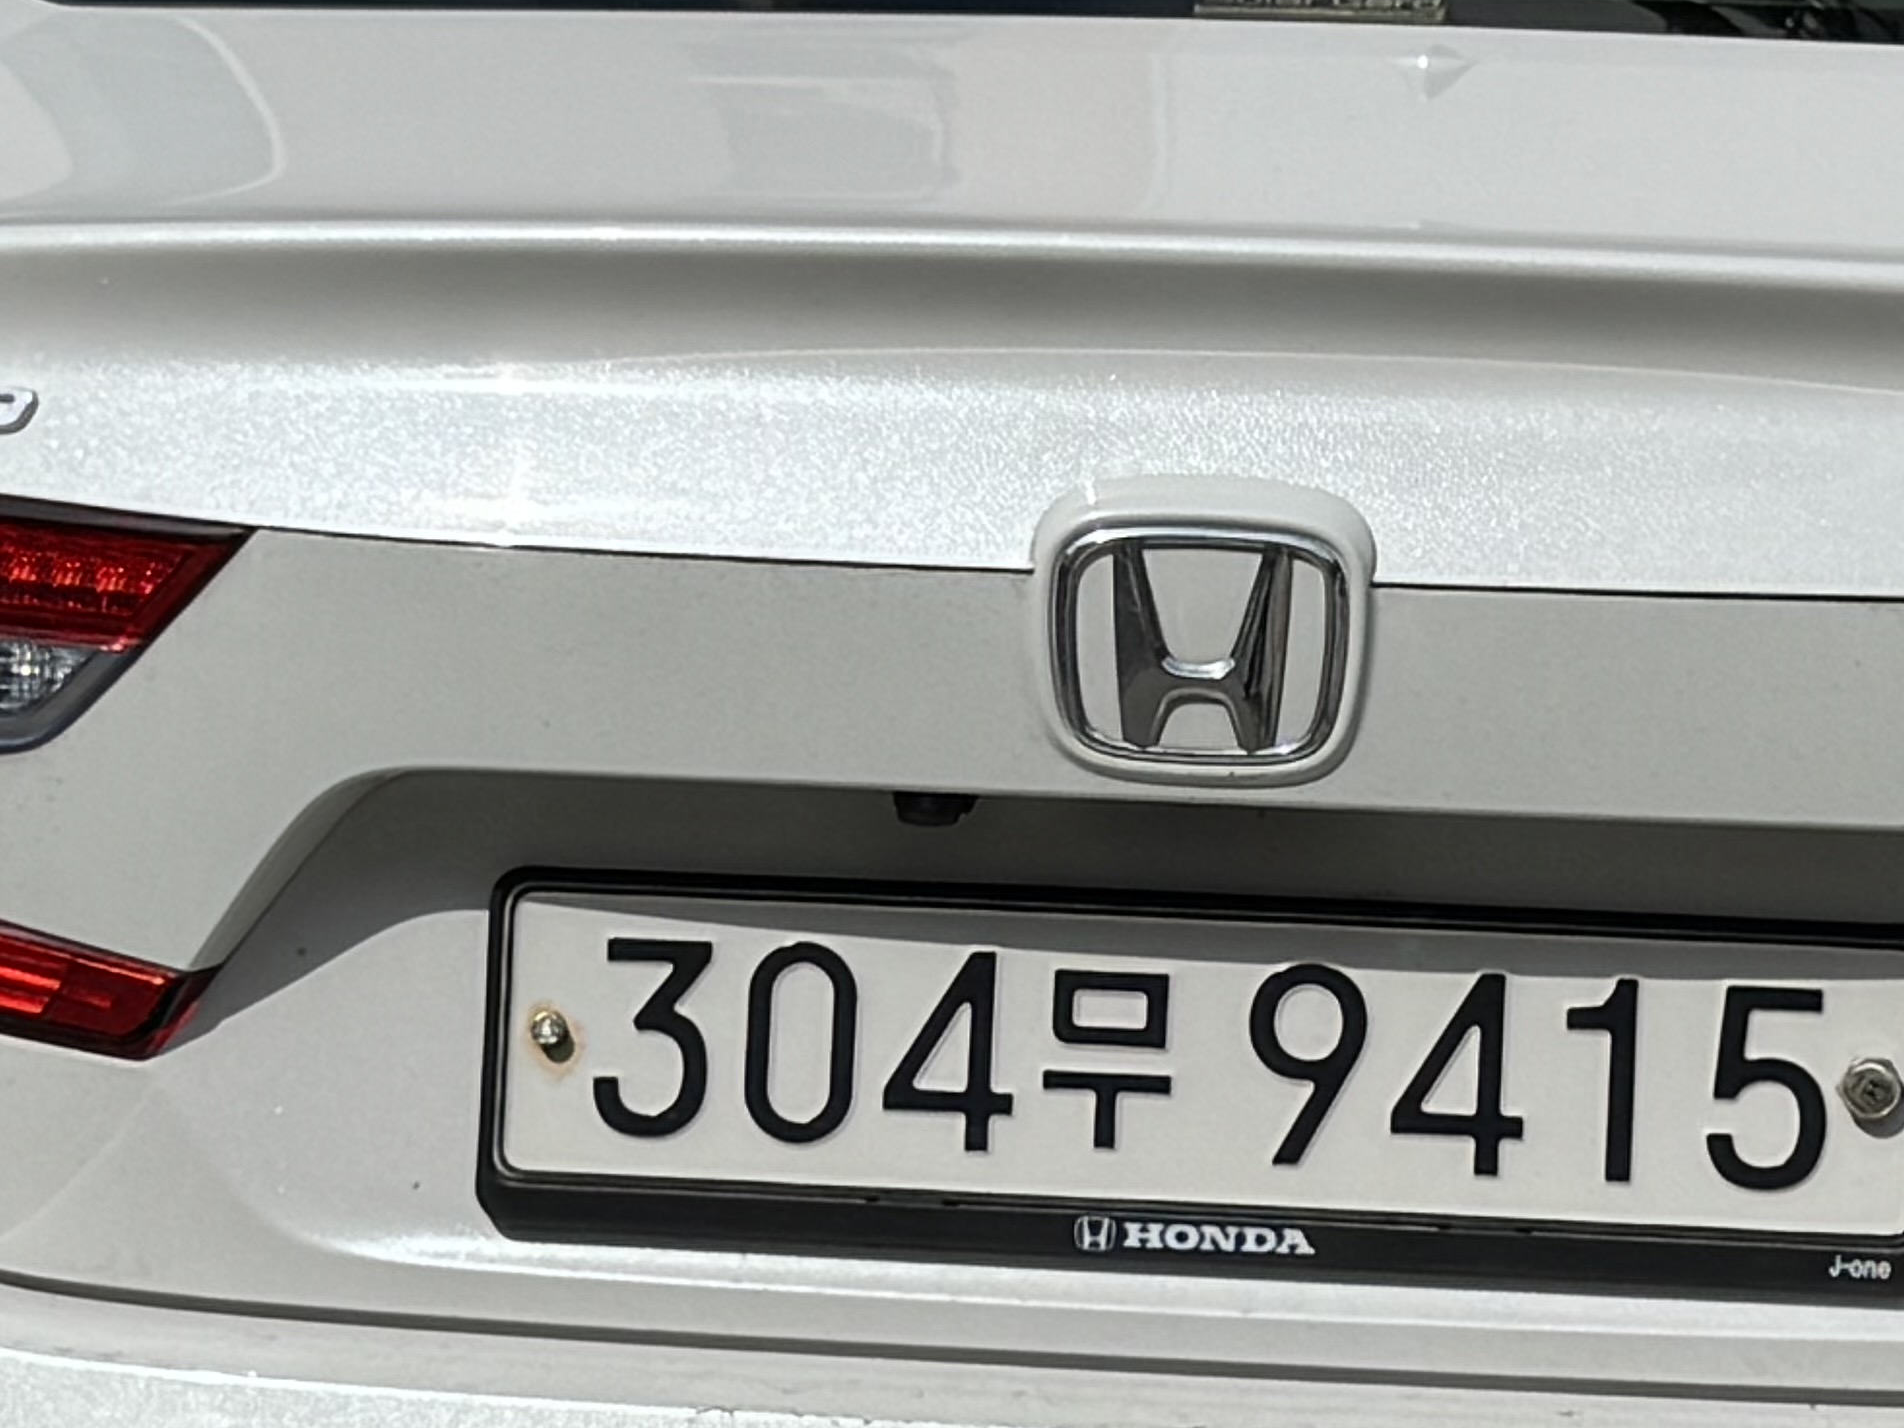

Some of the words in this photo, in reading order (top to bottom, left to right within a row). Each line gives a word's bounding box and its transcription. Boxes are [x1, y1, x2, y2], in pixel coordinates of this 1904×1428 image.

[590, 936, 1174, 1154] 304무
[1248, 962, 1830, 1190] 9415
[1123, 1221, 1316, 1256] HONDA
